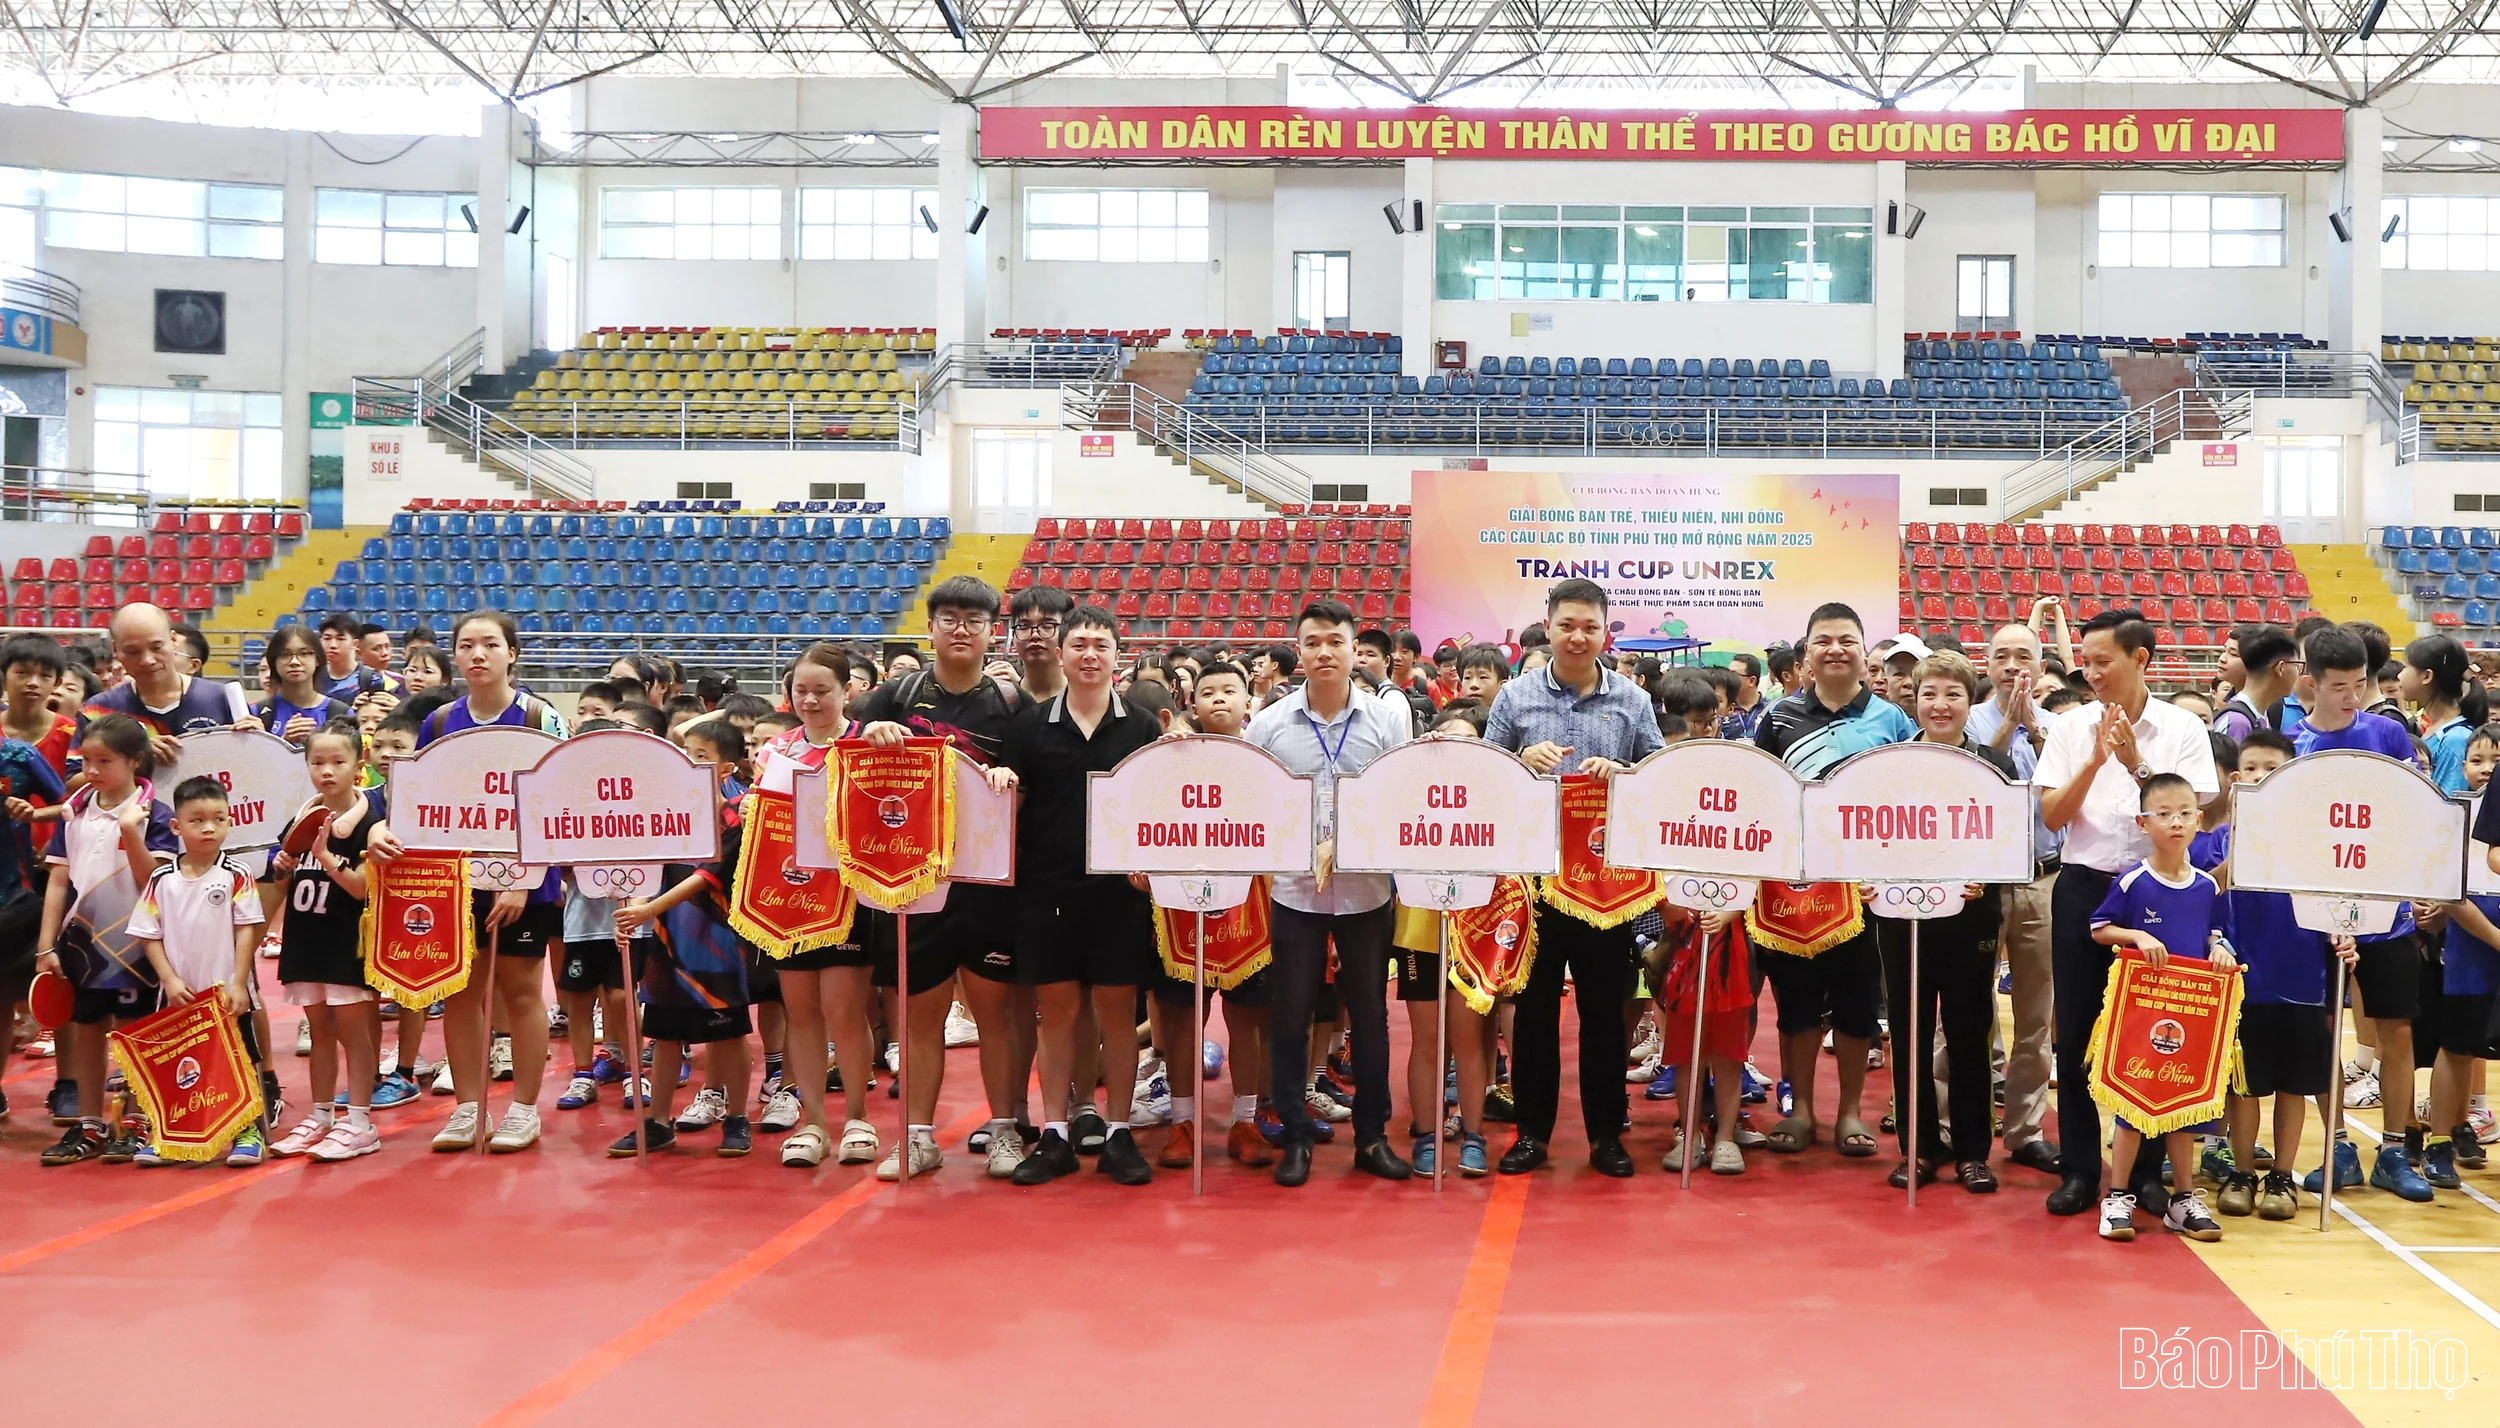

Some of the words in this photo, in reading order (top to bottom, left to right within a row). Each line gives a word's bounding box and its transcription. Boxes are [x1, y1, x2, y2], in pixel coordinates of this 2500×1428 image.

[1041, 114, 1148, 150] TOÀN
[1161, 114, 1246, 149] DÂN
[1261, 115, 1341, 149] RÈN
[1355, 115, 1486, 155] LUYỆN
[1498, 116, 1607, 150] THÂN
[1621, 111, 1697, 151] THỂ
[1710, 122, 1813, 152] THEO
[1826, 120, 1972, 152] GƯƠNG
[1985, 119, 2069, 152] BÁC
[2084, 114, 2138, 152] HỒ
[2152, 117, 2193, 152] VĨ
[2205, 122, 2276, 159] ĐẠI
[370, 442, 391, 454] KHU
[393, 442, 400, 454] B
[1509, 505, 1535, 522] GIẢI
[1539, 507, 1575, 523] BÓNG
[1579, 508, 1606, 523] BÀN
[1610, 507, 1637, 524] TRẺ,
[1641, 508, 1678, 524] THIẾU
[1682, 509, 1717, 525] NIÊN,
[1721, 512, 1744, 524] NHI
[1747, 507, 1784, 524] ĐỒNG
[1480, 528, 1506, 543] CÁC
[1510, 528, 1536, 544] CÂU
[1540, 531, 1564, 547] LẠC
[1569, 529, 1586, 547] BỘ
[1590, 528, 1619, 544] TỈNH
[1623, 530, 1649, 545] PHÚ
[1654, 533, 1678, 548] THỌ
[1682, 529, 1702, 545] MỞ
[1707, 529, 1742, 548] RỘNG
[1747, 530, 1777, 546] NĂM
[1781, 533, 1813, 546] 2025
[1517, 559, 1609, 579] TRANH
[1618, 560, 1674, 579] CUP
[1682, 561, 1775, 580] UNREX
[257, 609, 264, 617] C
[484, 771, 515, 795] CL
[597, 777, 634, 801] CLB
[1181, 784, 1222, 808] CLB
[1427, 784, 1467, 808] CLB
[1699, 786, 1737, 813] CLB
[417, 805, 450, 833] THỊ
[458, 802, 488, 830] XÃ
[544, 807, 585, 840] LIỄU
[592, 810, 644, 838] BÓNG
[650, 807, 691, 836] BÀN
[1838, 804, 1938, 848] TRỌNG
[1947, 797, 1994, 840] TÀI
[2329, 802, 2371, 830] CLB
[1137, 823, 1198, 847] ĐOAN
[1205, 818, 1265, 847] HÙNG
[1400, 814, 1443, 847] BẢO
[1449, 823, 1495, 847] ANH
[1659, 814, 1727, 850] THẮNG
[1733, 820, 1772, 853] LỐP
[2332, 843, 2366, 870] 1/6
[293, 879, 331, 914] 01
[1406, 954, 1418, 981] YONEX
[2141, 972, 2158, 984] GIẢI
[2159, 975, 2180, 987] BÓNG
[2181, 979, 2197, 990] BÀN
[2198, 982, 2213, 992] TRẺ
[2196, 1007, 2210, 1017] 2025
